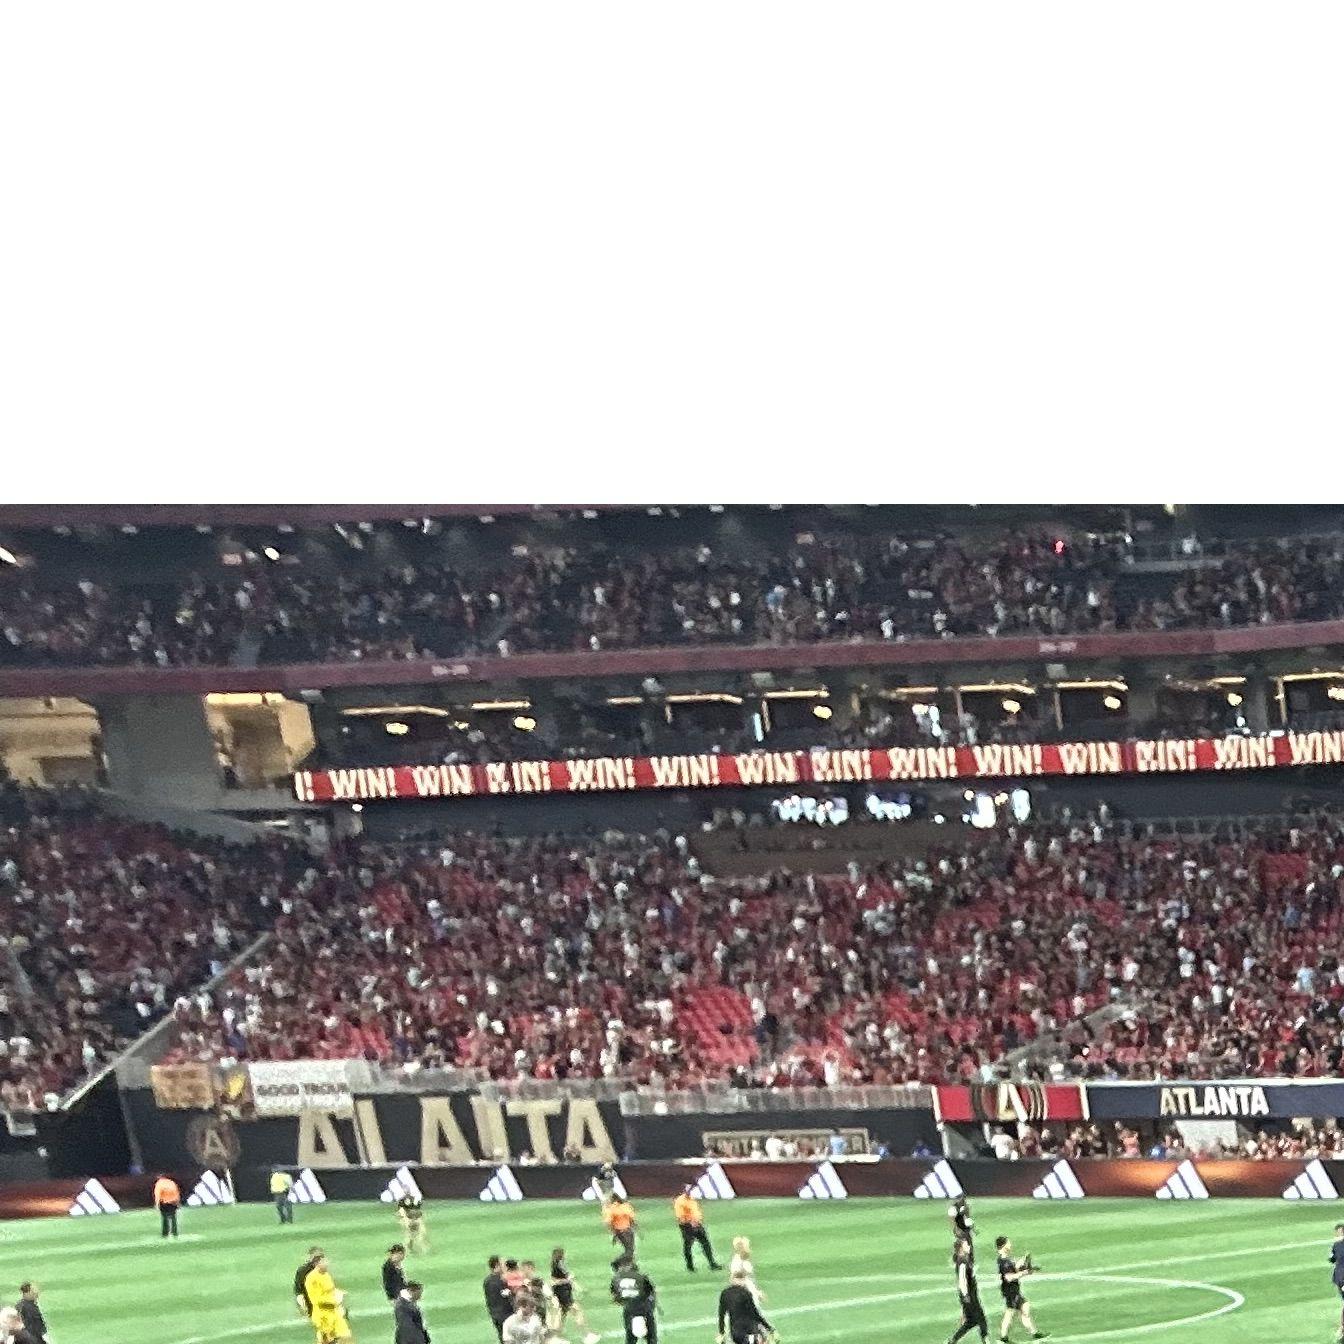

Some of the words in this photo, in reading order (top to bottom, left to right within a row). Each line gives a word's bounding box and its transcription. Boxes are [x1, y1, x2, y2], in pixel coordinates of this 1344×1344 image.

[329, 769, 396, 798] WIN!
[567, 759, 635, 789] WIN!
[651, 755, 719, 785] WIN!
[887, 748, 957, 778] WIN!
[973, 745, 1042, 775] WIN!
[1214, 735, 1275, 768] WIN!
[1160, 1087, 1269, 1116] ATLANTA
